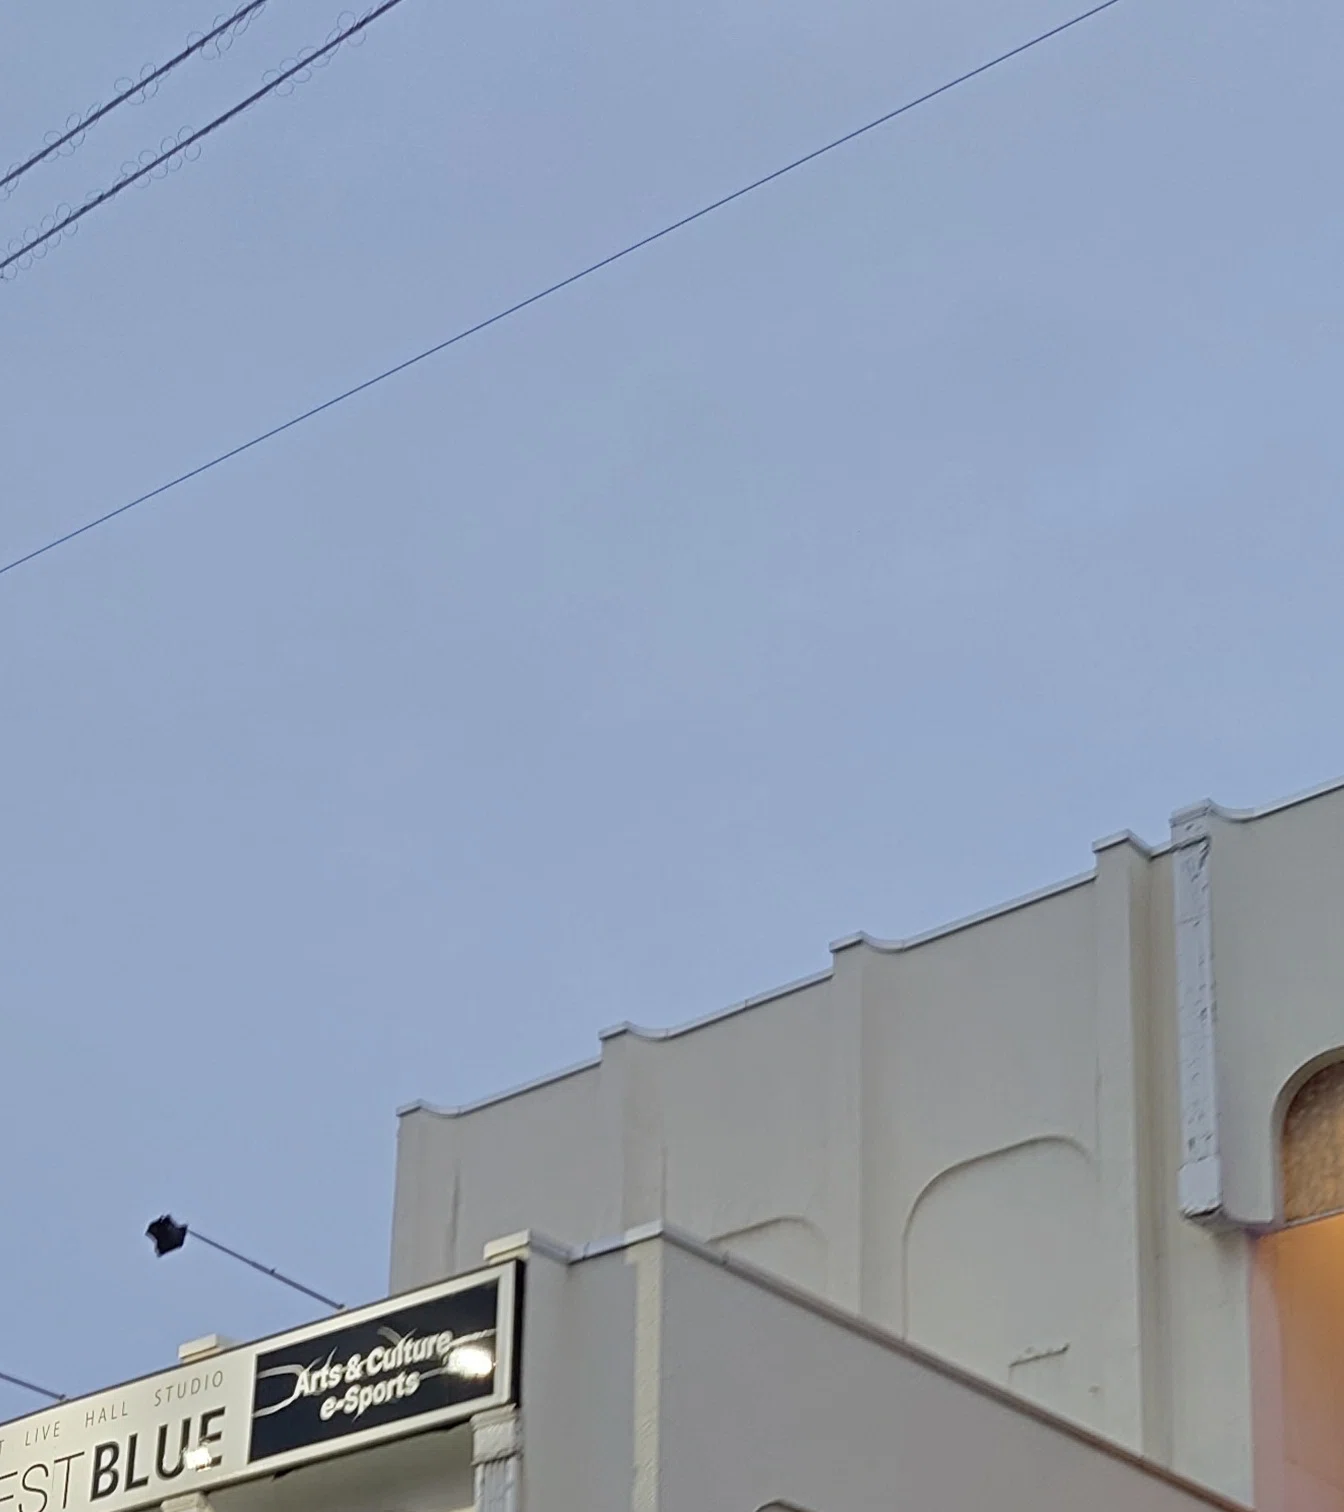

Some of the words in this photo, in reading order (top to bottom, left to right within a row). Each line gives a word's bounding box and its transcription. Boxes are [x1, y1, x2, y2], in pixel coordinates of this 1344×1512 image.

[294, 1348, 343, 1398] Arts
[366, 1329, 454, 1376] Culture
[320, 1370, 420, 1422] e-Sports
[25, 1421, 61, 1447] LIVE
[85, 1402, 128, 1428] HALL
[154, 1370, 224, 1407] STUDIO
